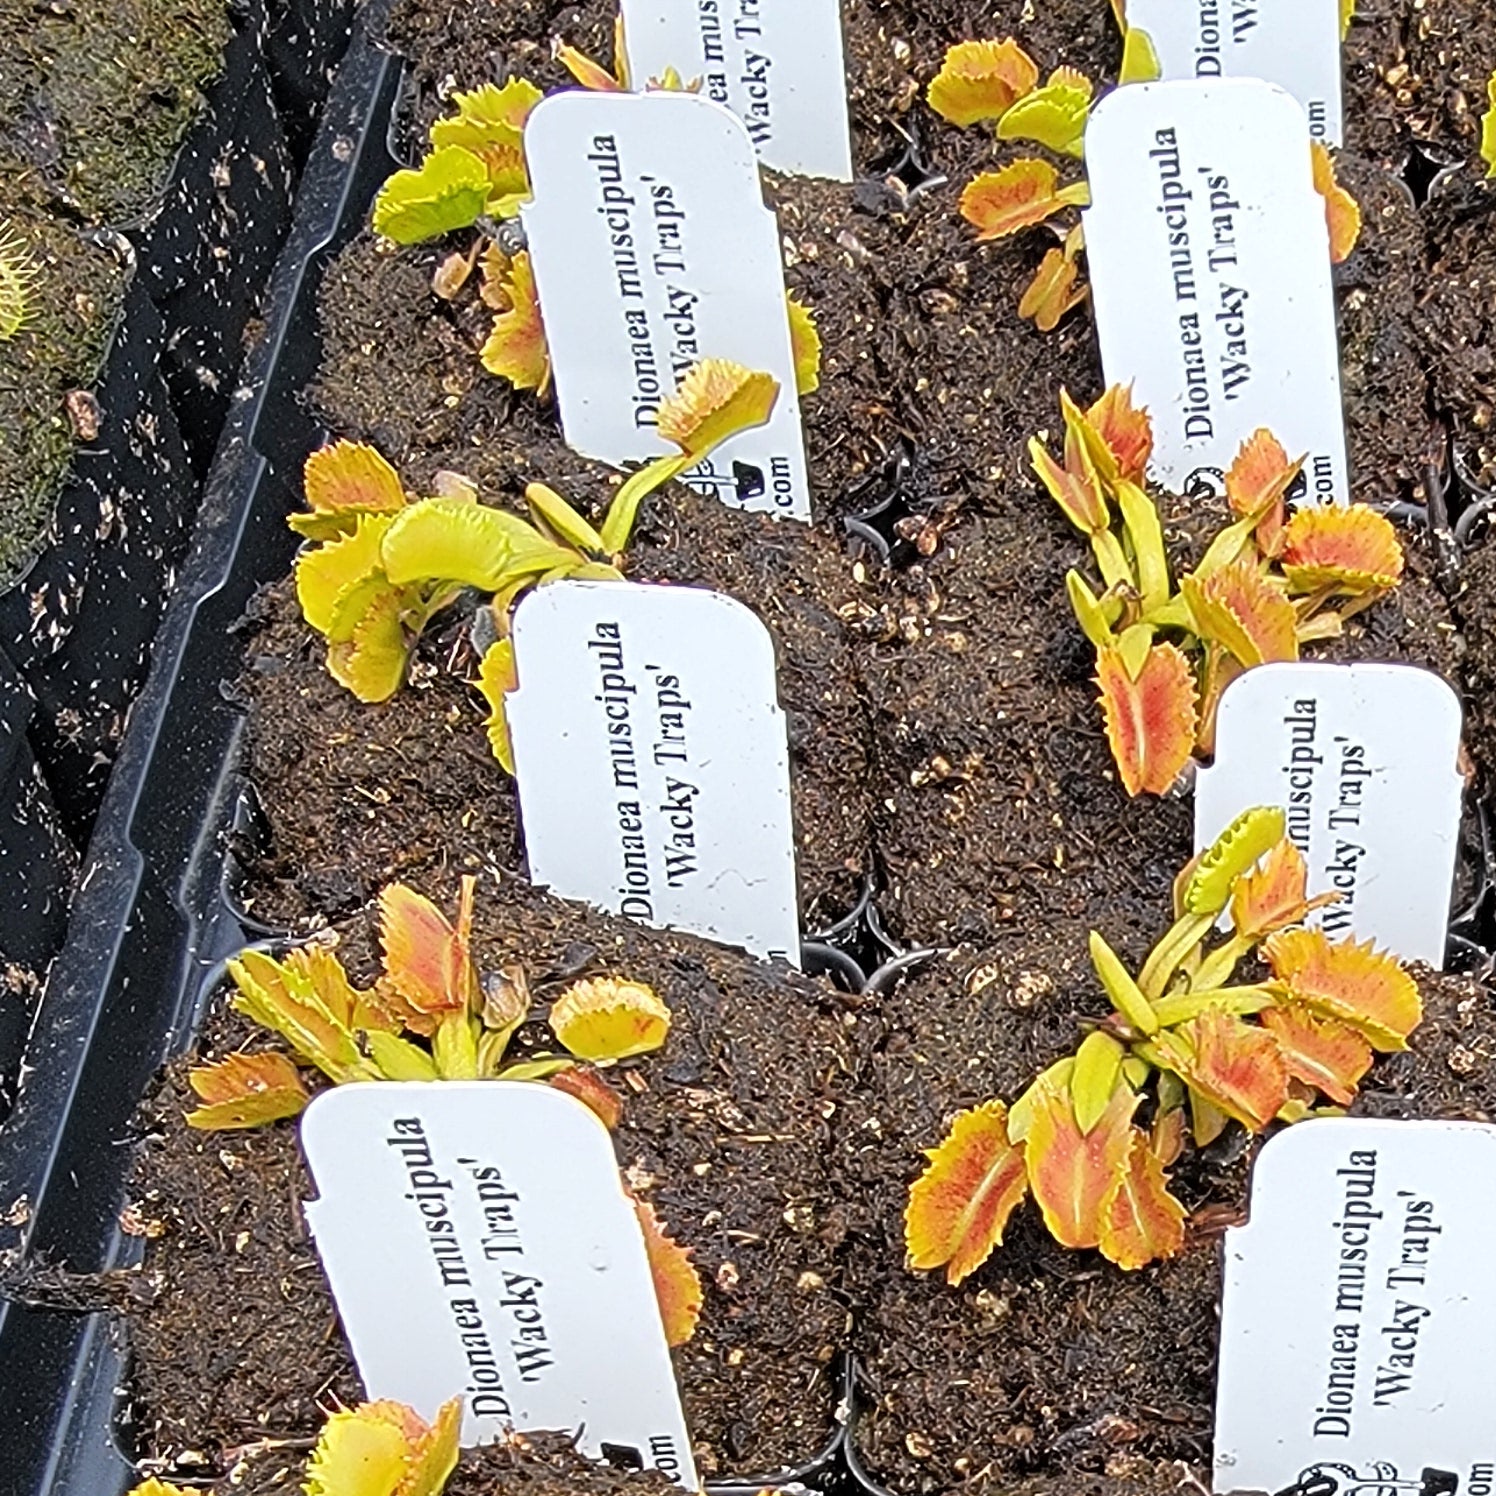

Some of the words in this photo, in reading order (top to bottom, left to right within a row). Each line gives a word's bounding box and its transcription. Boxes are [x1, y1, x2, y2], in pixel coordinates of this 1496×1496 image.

[588, 135, 642, 302] muscipula
[640, 176, 686, 275] Traps'
[1150, 127, 1197, 302] muscipula
[1199, 167, 1240, 274] Traps'
[629, 310, 659, 429] Dionaea
[1177, 313, 1214, 440] Dionaea
[1216, 282, 1252, 400] 'Wacky
[588, 621, 639, 790] muscipula
[645, 665, 691, 766] Traps'
[660, 776, 700, 888] 'Wacky
[1283, 698, 1323, 853] muscipula
[1329, 736, 1372, 831] Traps'
[617, 801, 654, 921] Dionaea
[387, 1116, 472, 1288] muscipula
[457, 1157, 525, 1261] Traps'
[1332, 1149, 1384, 1313] muscipula
[1386, 1190, 1442, 1290] Traps'
[450, 1299, 512, 1419] Dionaea
[501, 1270, 555, 1383] 'Wacky
[1313, 1323, 1360, 1438] Dionaea
[1373, 1299, 1432, 1407] 'Wacky
